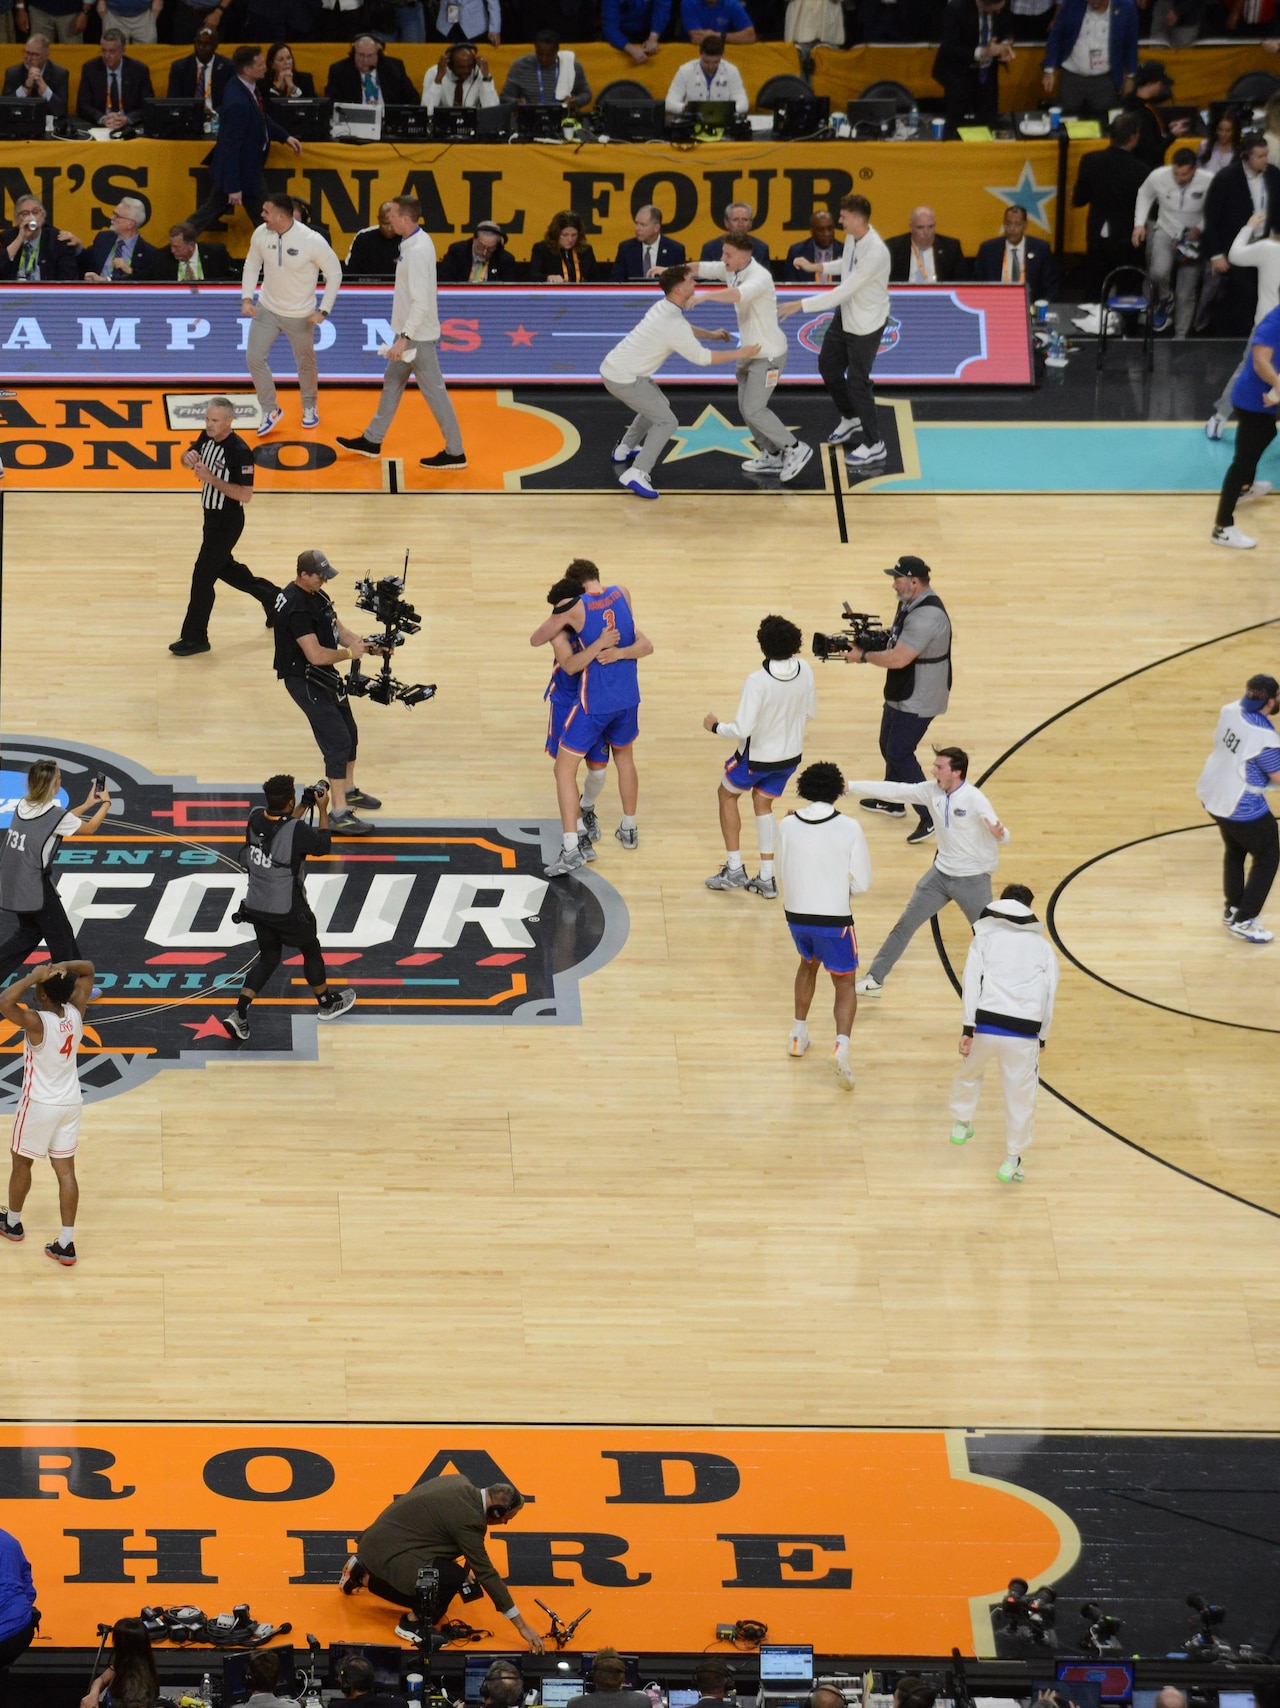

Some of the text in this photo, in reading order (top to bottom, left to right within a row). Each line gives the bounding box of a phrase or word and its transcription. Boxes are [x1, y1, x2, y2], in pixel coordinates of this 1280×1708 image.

[1222, 728, 1241, 754] 181
[6, 828, 27, 852] 731
[59, 1034, 74, 1061] 4
